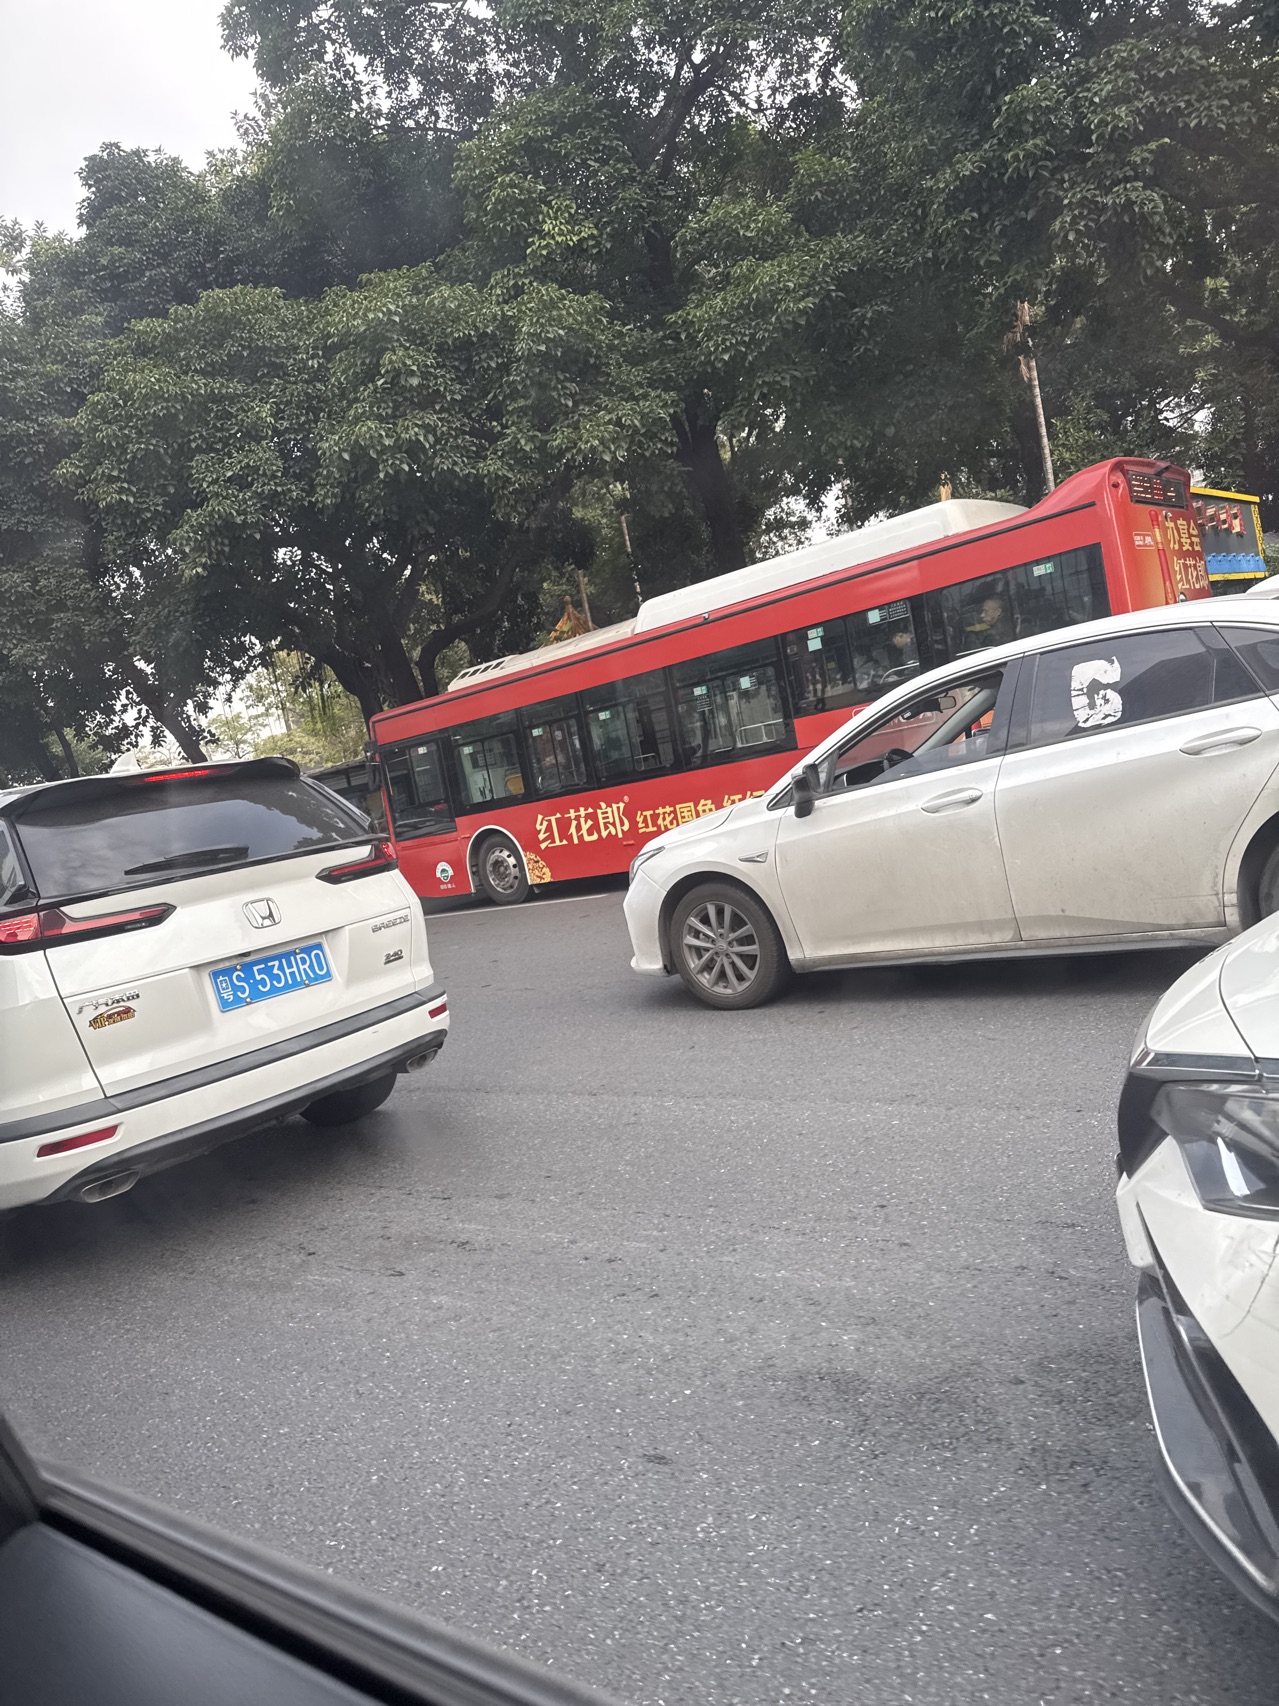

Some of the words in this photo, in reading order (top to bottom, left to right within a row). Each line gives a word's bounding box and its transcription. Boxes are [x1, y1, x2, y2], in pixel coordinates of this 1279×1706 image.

[1165, 518, 1202, 551] 办宴会
[1173, 556, 1209, 590] 红花郎
[535, 801, 630, 850] 红花郎
